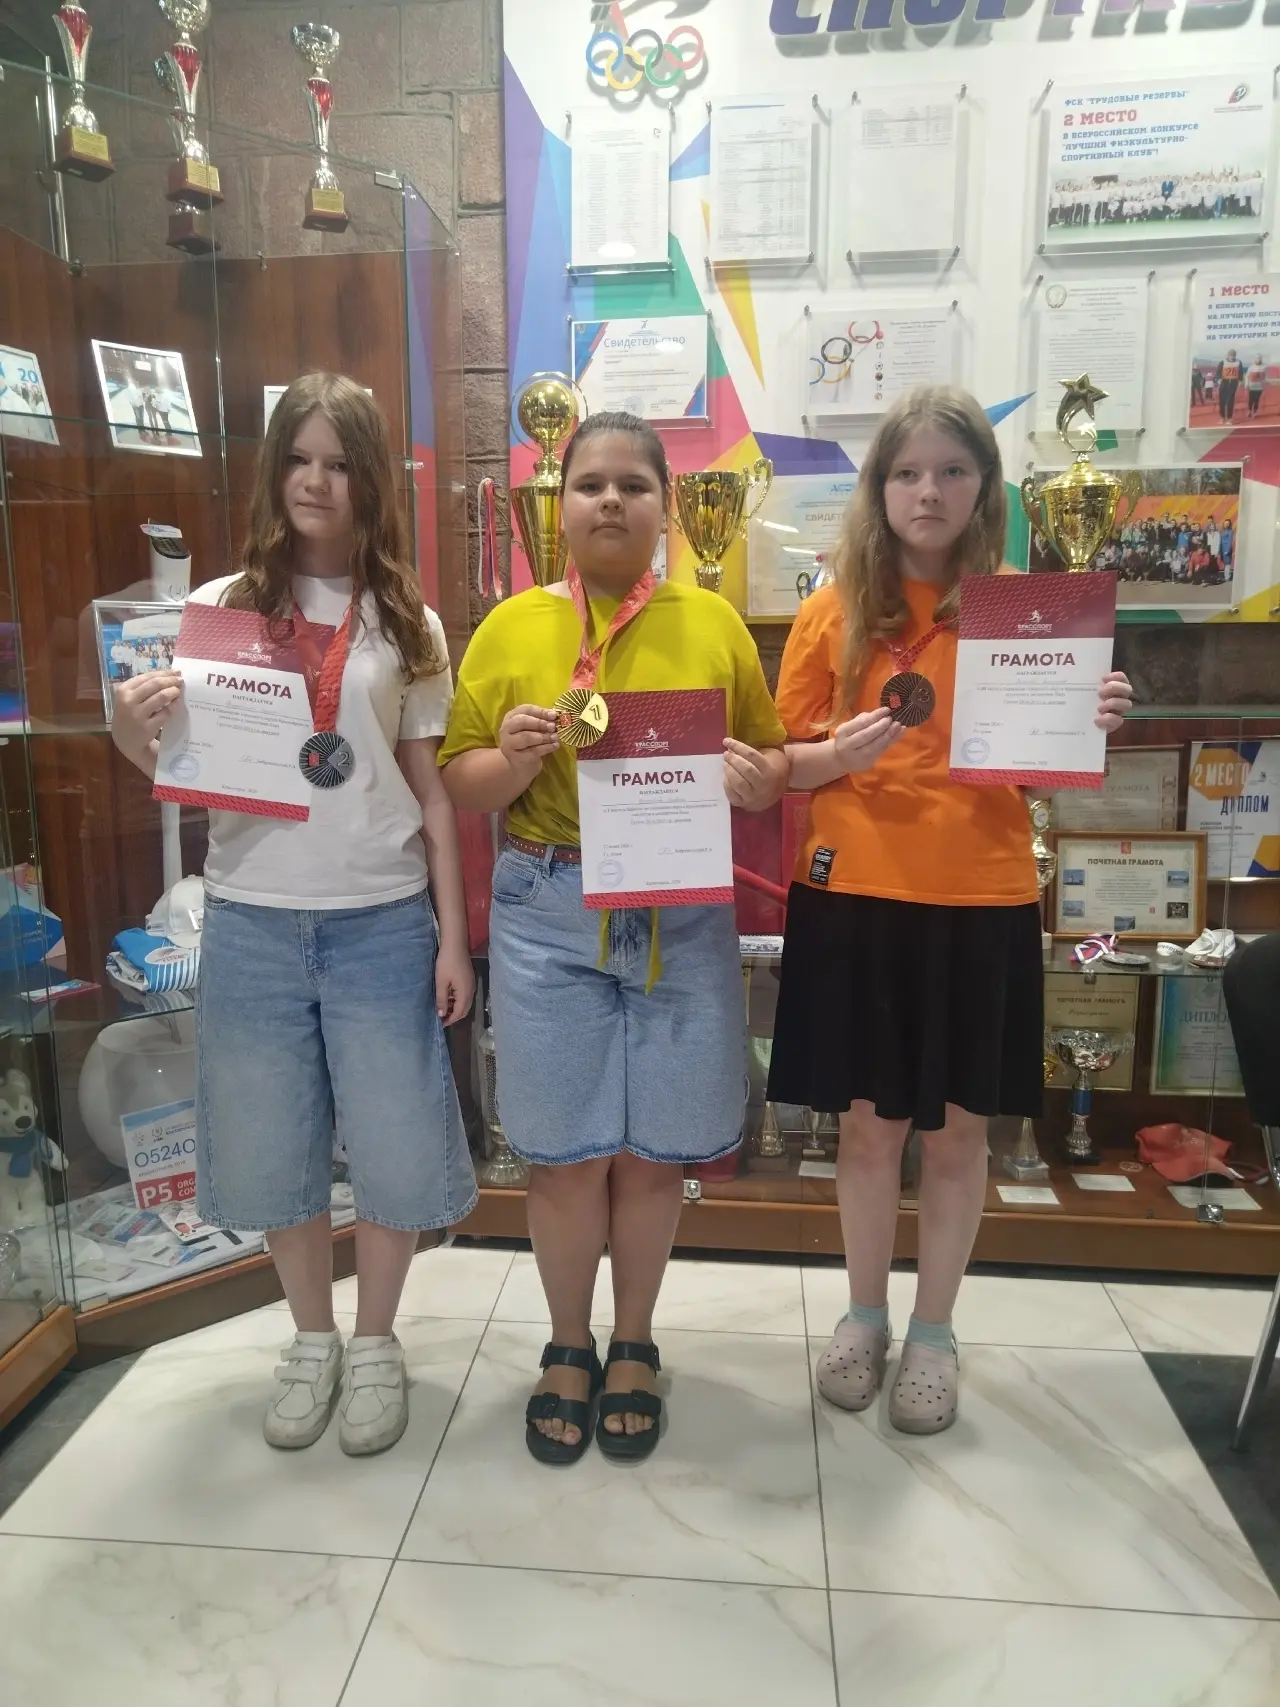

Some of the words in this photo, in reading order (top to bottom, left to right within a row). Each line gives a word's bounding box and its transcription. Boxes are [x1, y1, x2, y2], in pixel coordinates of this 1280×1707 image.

[1063, 114, 1074, 126] 2
[1080, 109, 1137, 125] МЕСТО
[1072, 127, 1147, 139] ВСЕРОССИЙСКОМ
[1151, 123, 1199, 133] КОНКУРСЕ
[1061, 150, 1124, 161] СПОРТИВНЫЙ
[1209, 287, 1215, 297] 1
[1221, 284, 1270, 296] МЕСТО
[991, 652, 1076, 667] ГРАМОТА
[206, 672, 293, 700] ГРАМОТА
[590, 703, 602, 721] 1
[337, 750, 350, 767] 2
[612, 770, 696, 787] ГРАМОТА
[1194, 763, 1203, 787] 2
[1088, 858, 1127, 866] ПОЧЕТНАЯ
[1129, 859, 1164, 867] ГРАМОТА
[177, 1177, 196, 1189] ORG
[141, 1182, 173, 1208] P5
